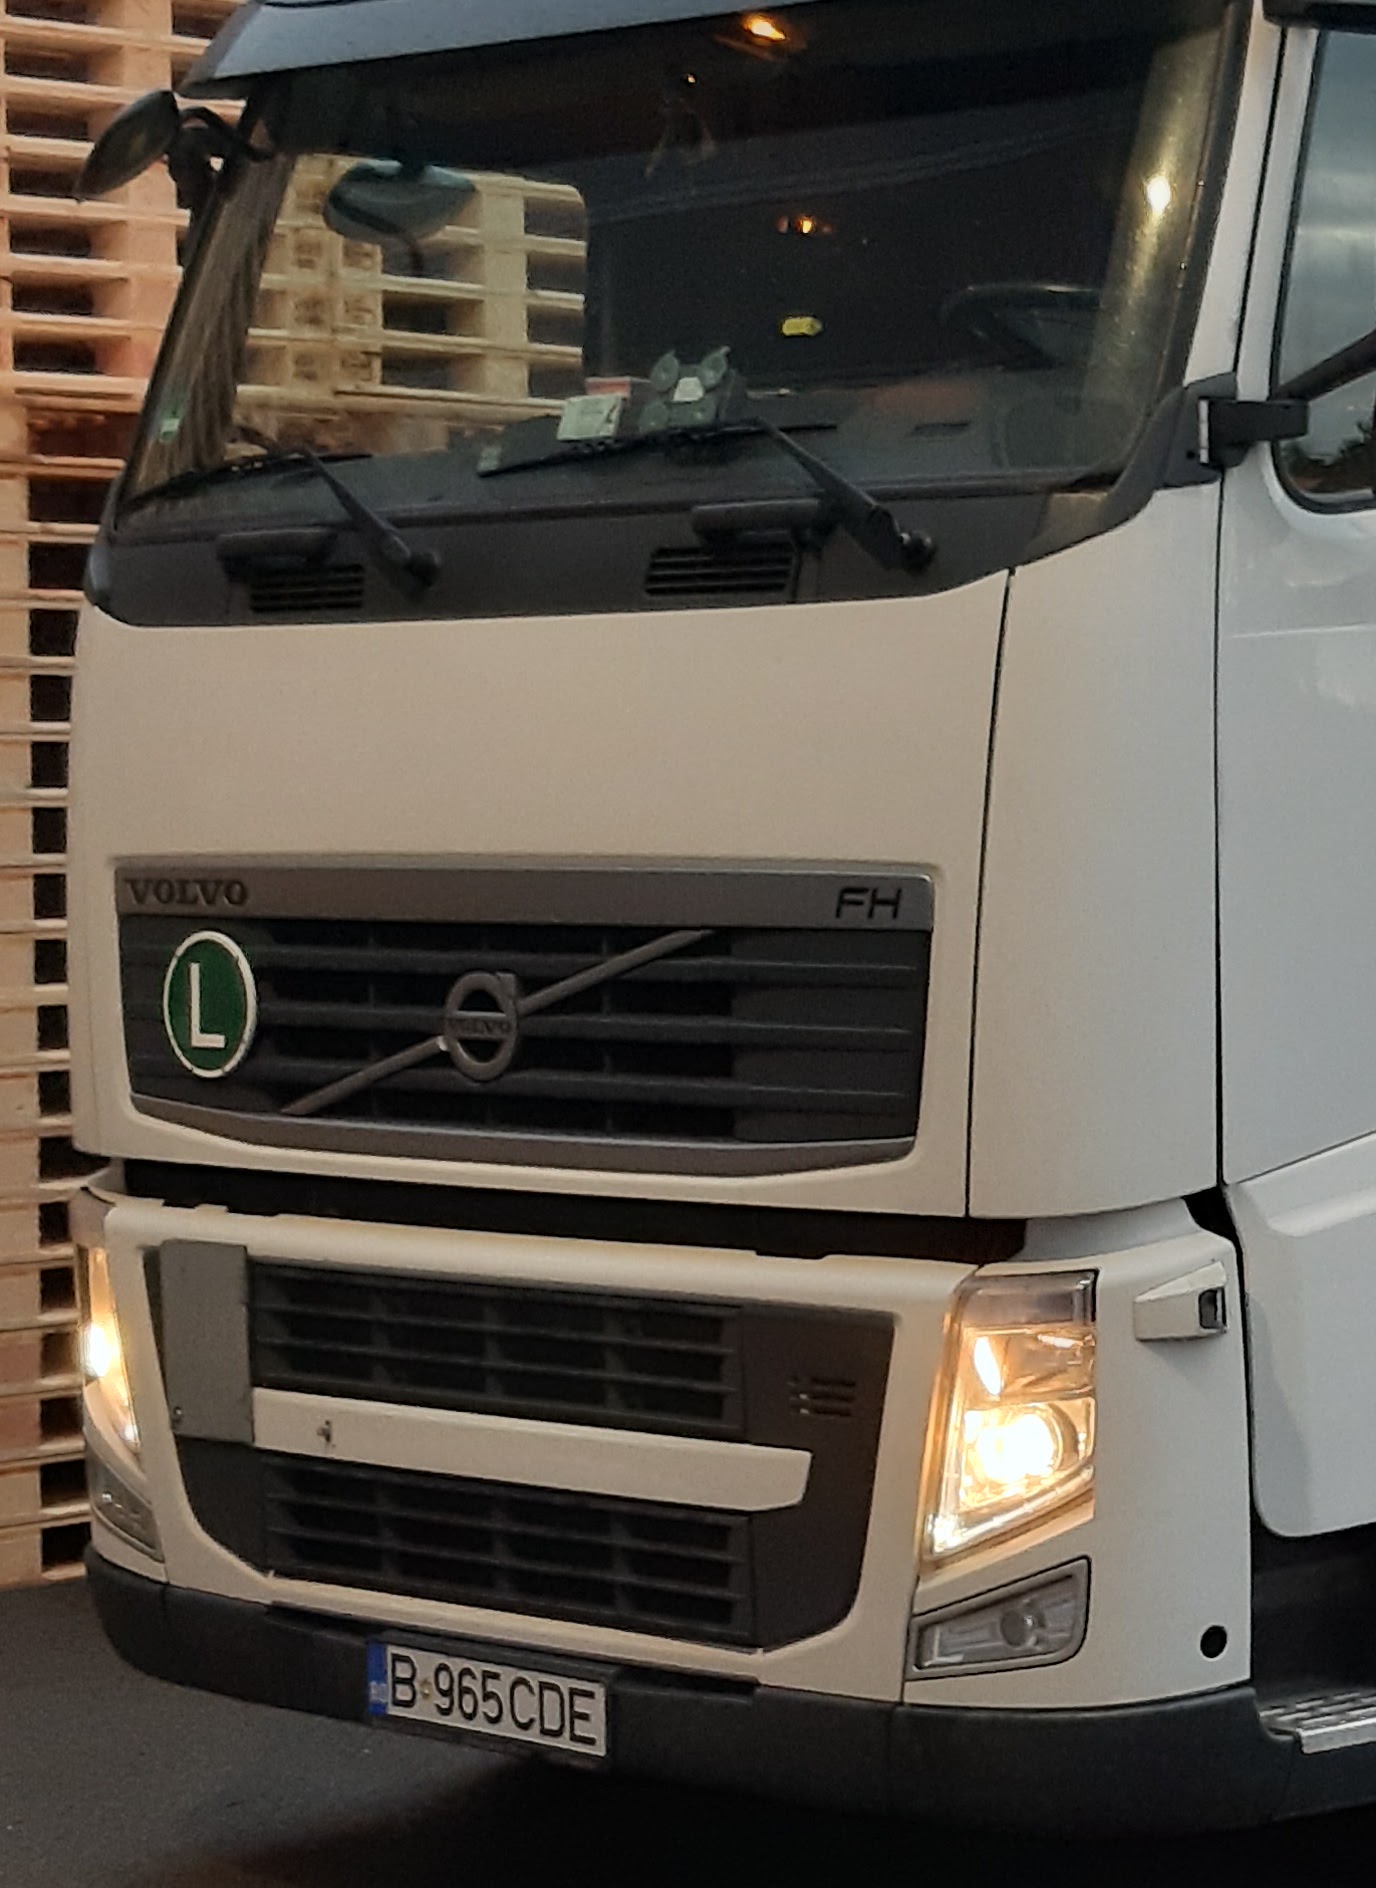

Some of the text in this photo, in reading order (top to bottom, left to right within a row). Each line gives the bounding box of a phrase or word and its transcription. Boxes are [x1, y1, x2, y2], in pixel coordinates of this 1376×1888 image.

[127, 878, 250, 907] VOLVO
[836, 888, 902, 919] FH
[190, 962, 226, 1049] L
